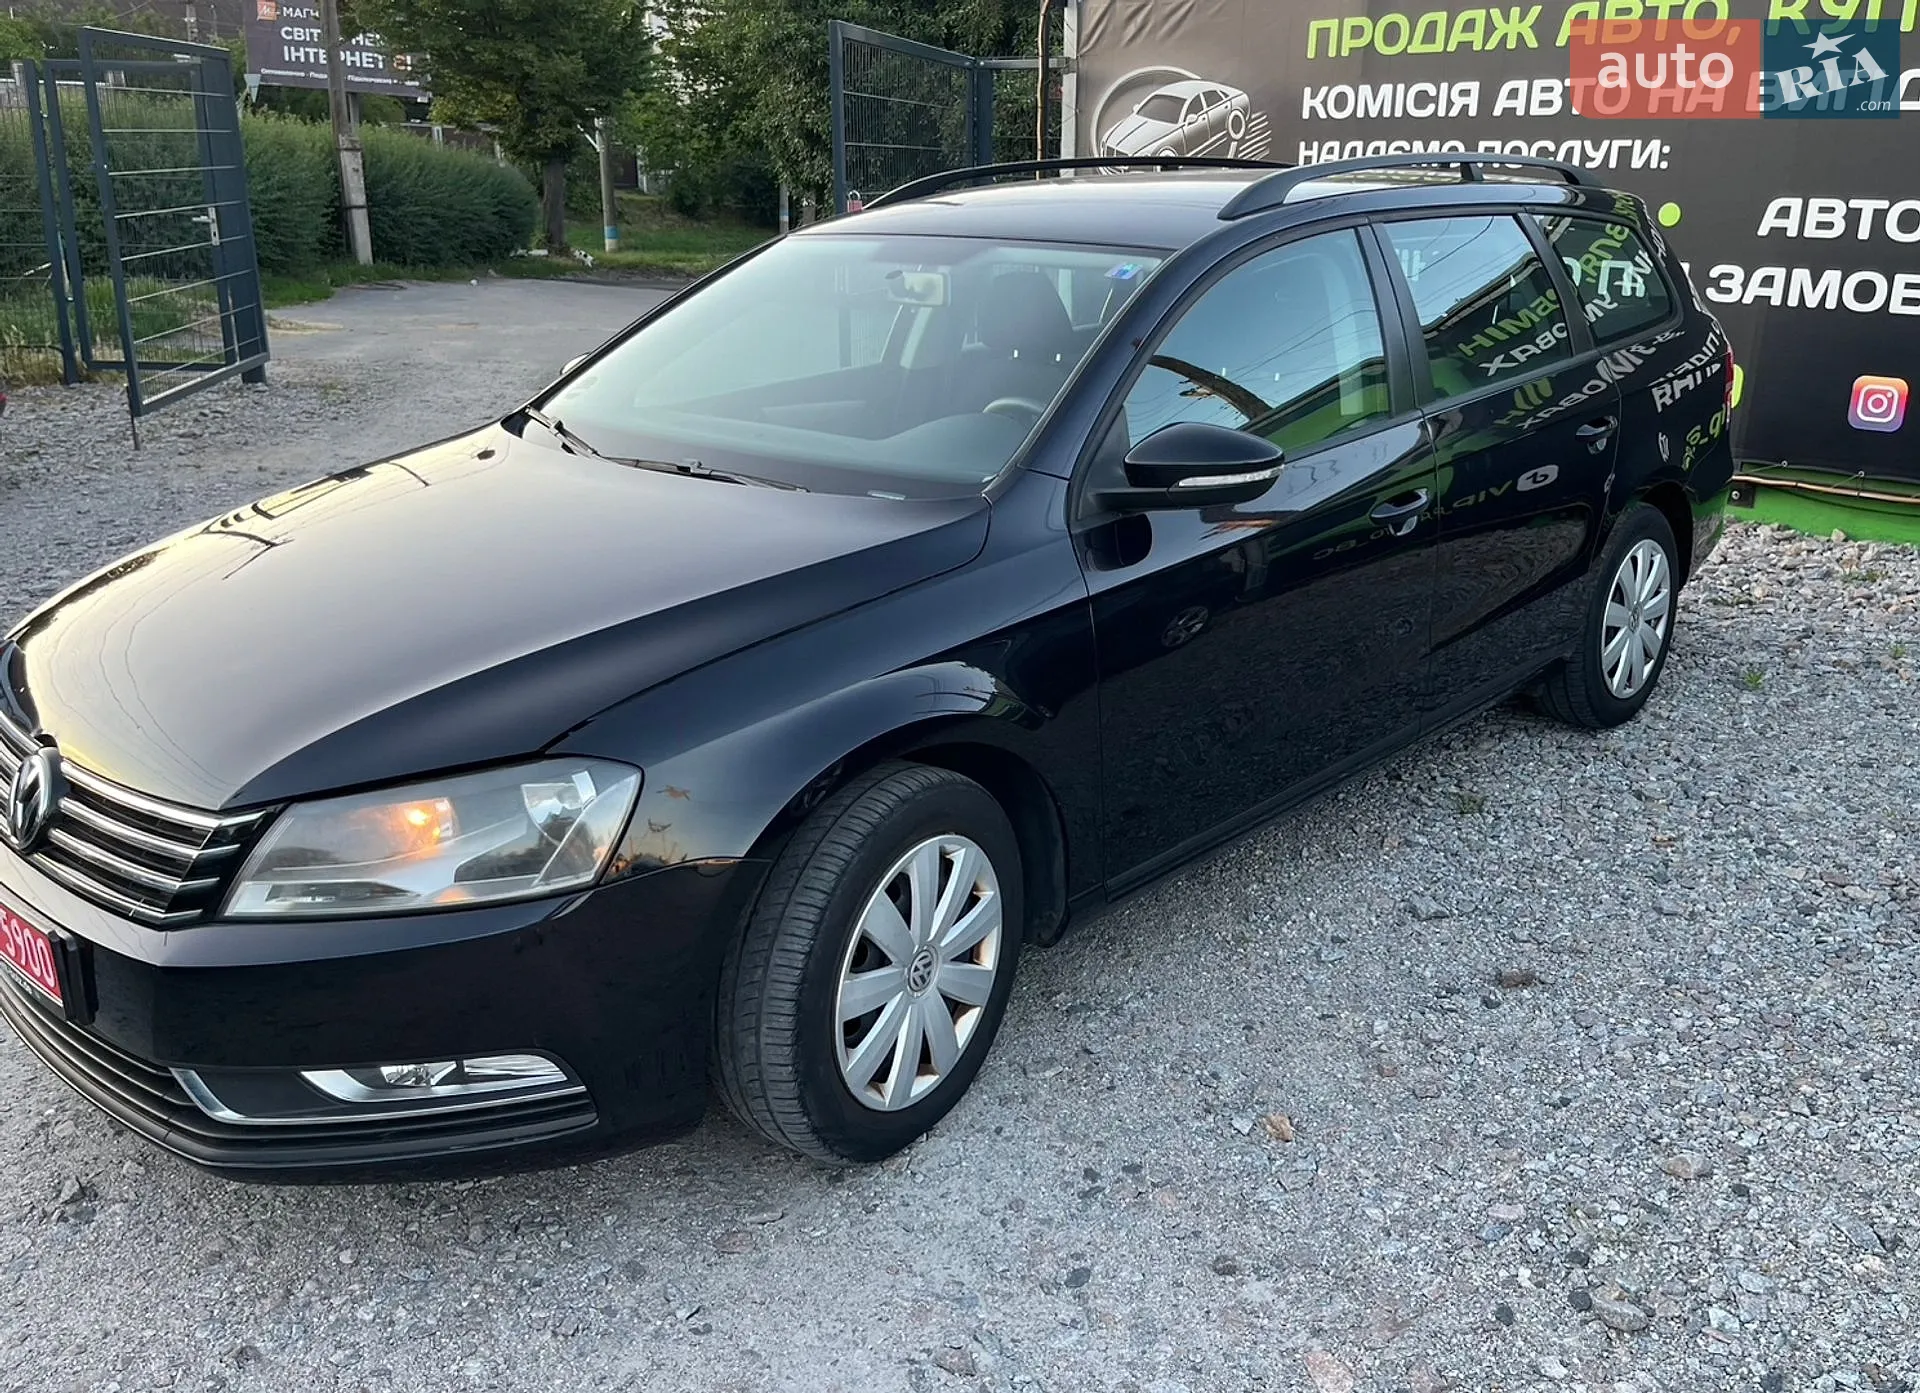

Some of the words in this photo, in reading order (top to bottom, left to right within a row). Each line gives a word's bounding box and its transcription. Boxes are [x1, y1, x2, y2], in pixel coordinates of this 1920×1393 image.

[1308, 5, 1541, 58] ПРОДАЖ
[1555, 0, 1741, 47] АВТО,
[1302, 81, 1480, 121] КОМІСІЯ
[1492, 77, 1631, 116] АВТО
[1647, 75, 1726, 113] НА
[1757, 197, 1920, 243] АВТО
